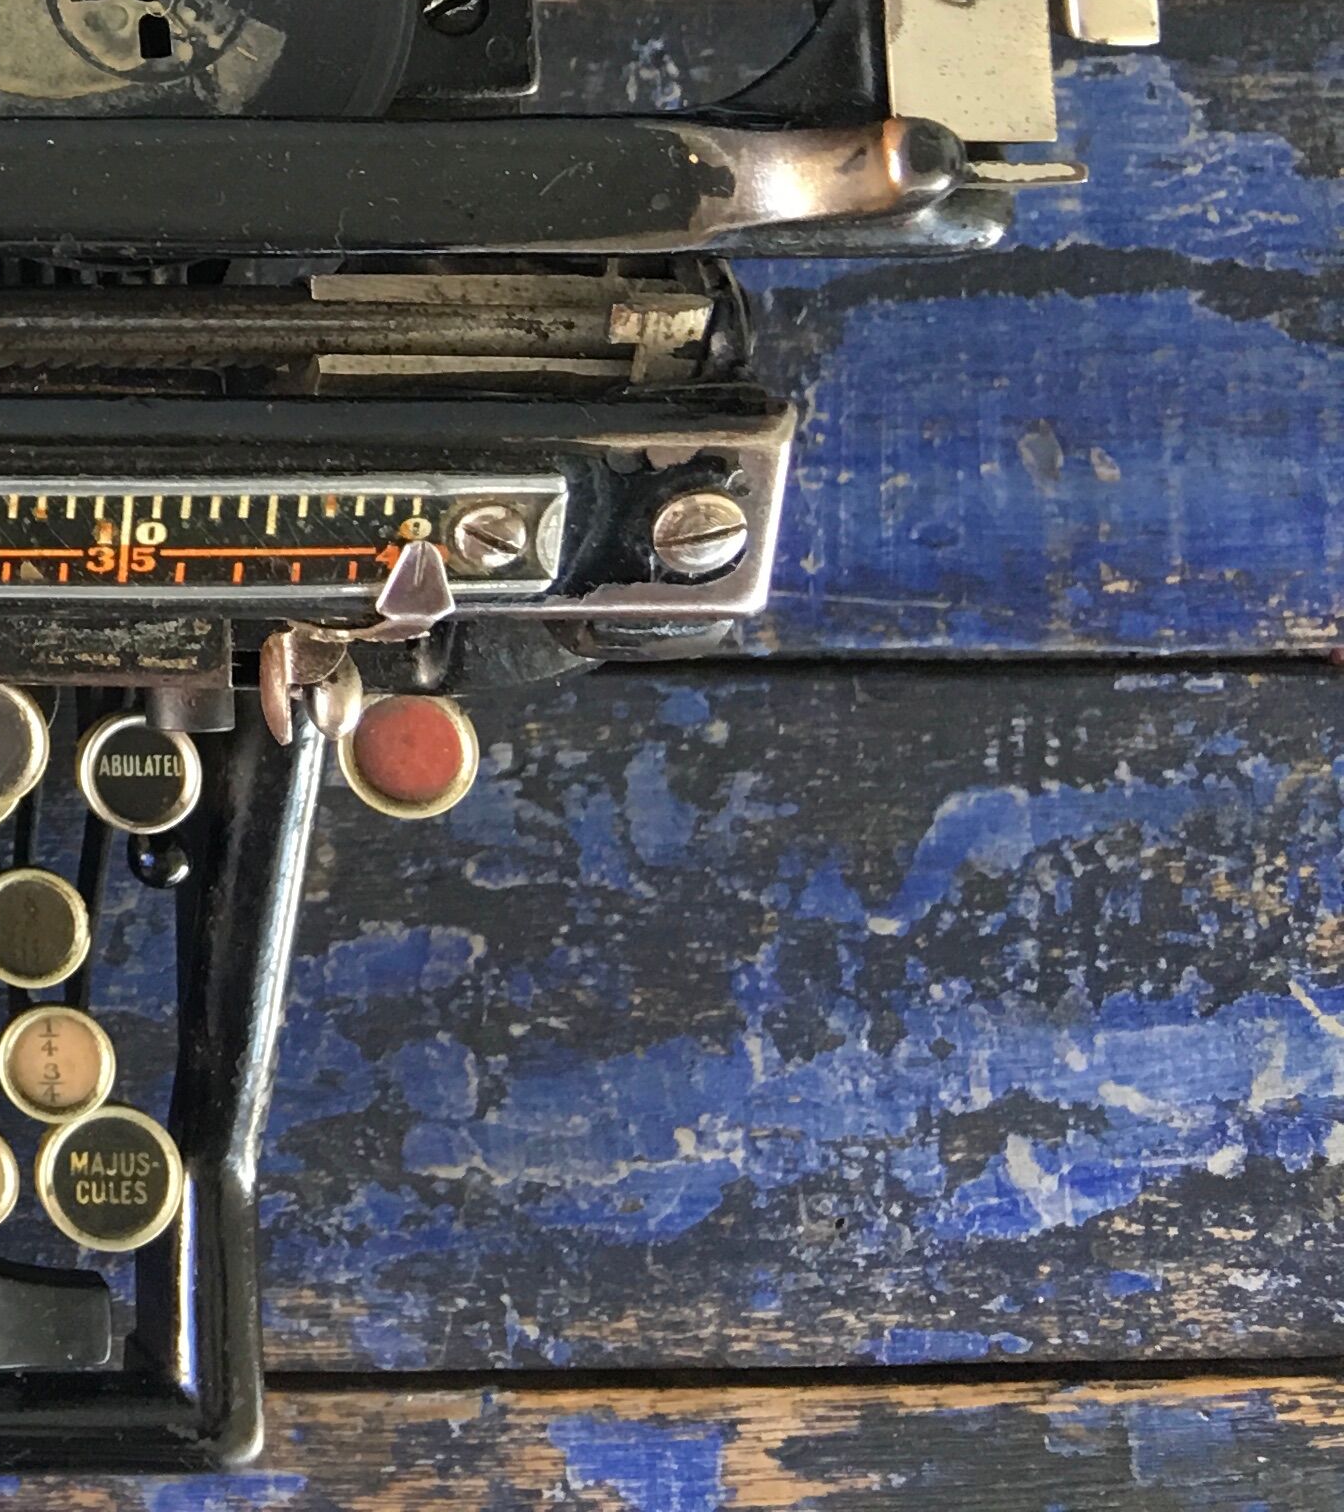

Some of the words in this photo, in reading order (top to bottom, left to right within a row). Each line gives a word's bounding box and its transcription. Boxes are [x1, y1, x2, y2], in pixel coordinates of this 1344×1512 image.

[86, 547, 156, 572] 35
[69, 1151, 160, 1178] MAJUS-
[75, 1180, 147, 1206] CULES
